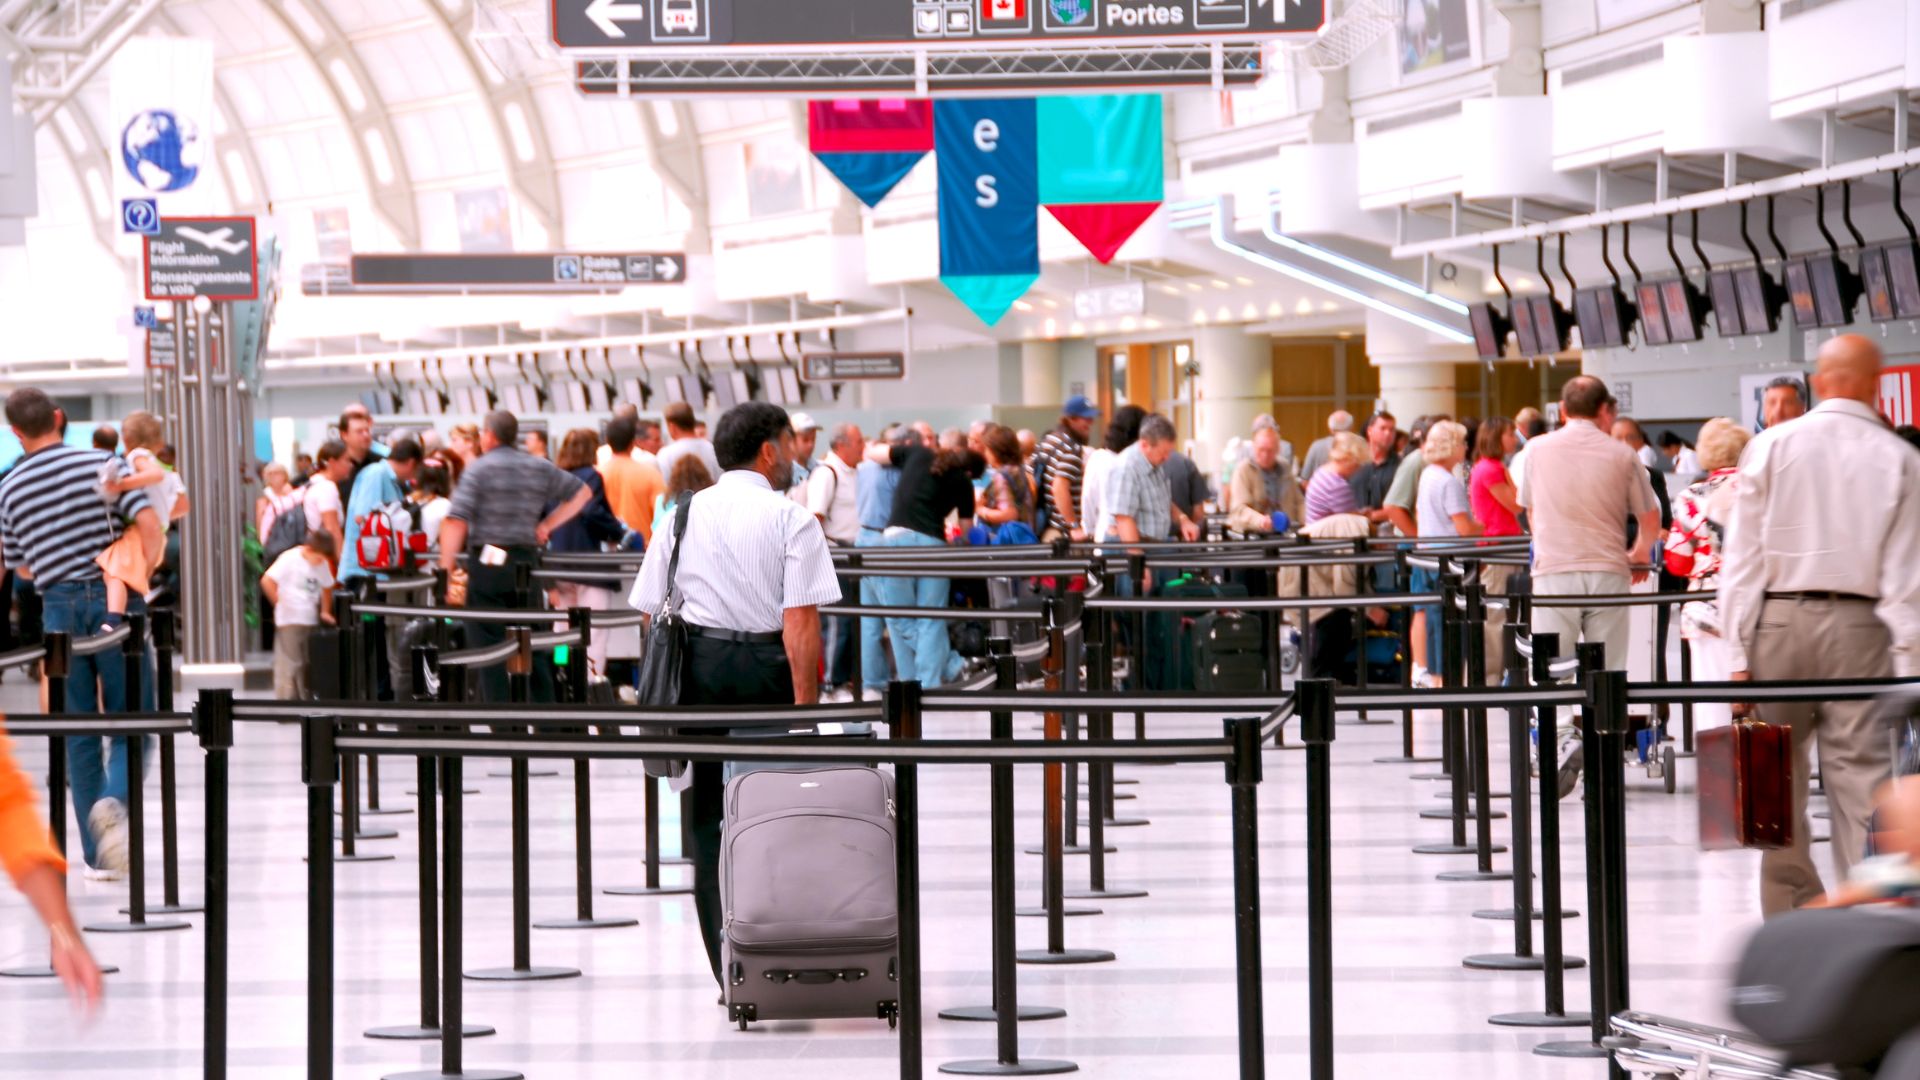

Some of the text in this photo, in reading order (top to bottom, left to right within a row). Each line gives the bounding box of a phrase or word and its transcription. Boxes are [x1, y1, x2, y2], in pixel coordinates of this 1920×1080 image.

[1106, 3, 1184, 26] Portes
[150, 241, 185, 255] Flight
[150, 253, 220, 266] Information
[151, 283, 168, 296] de
